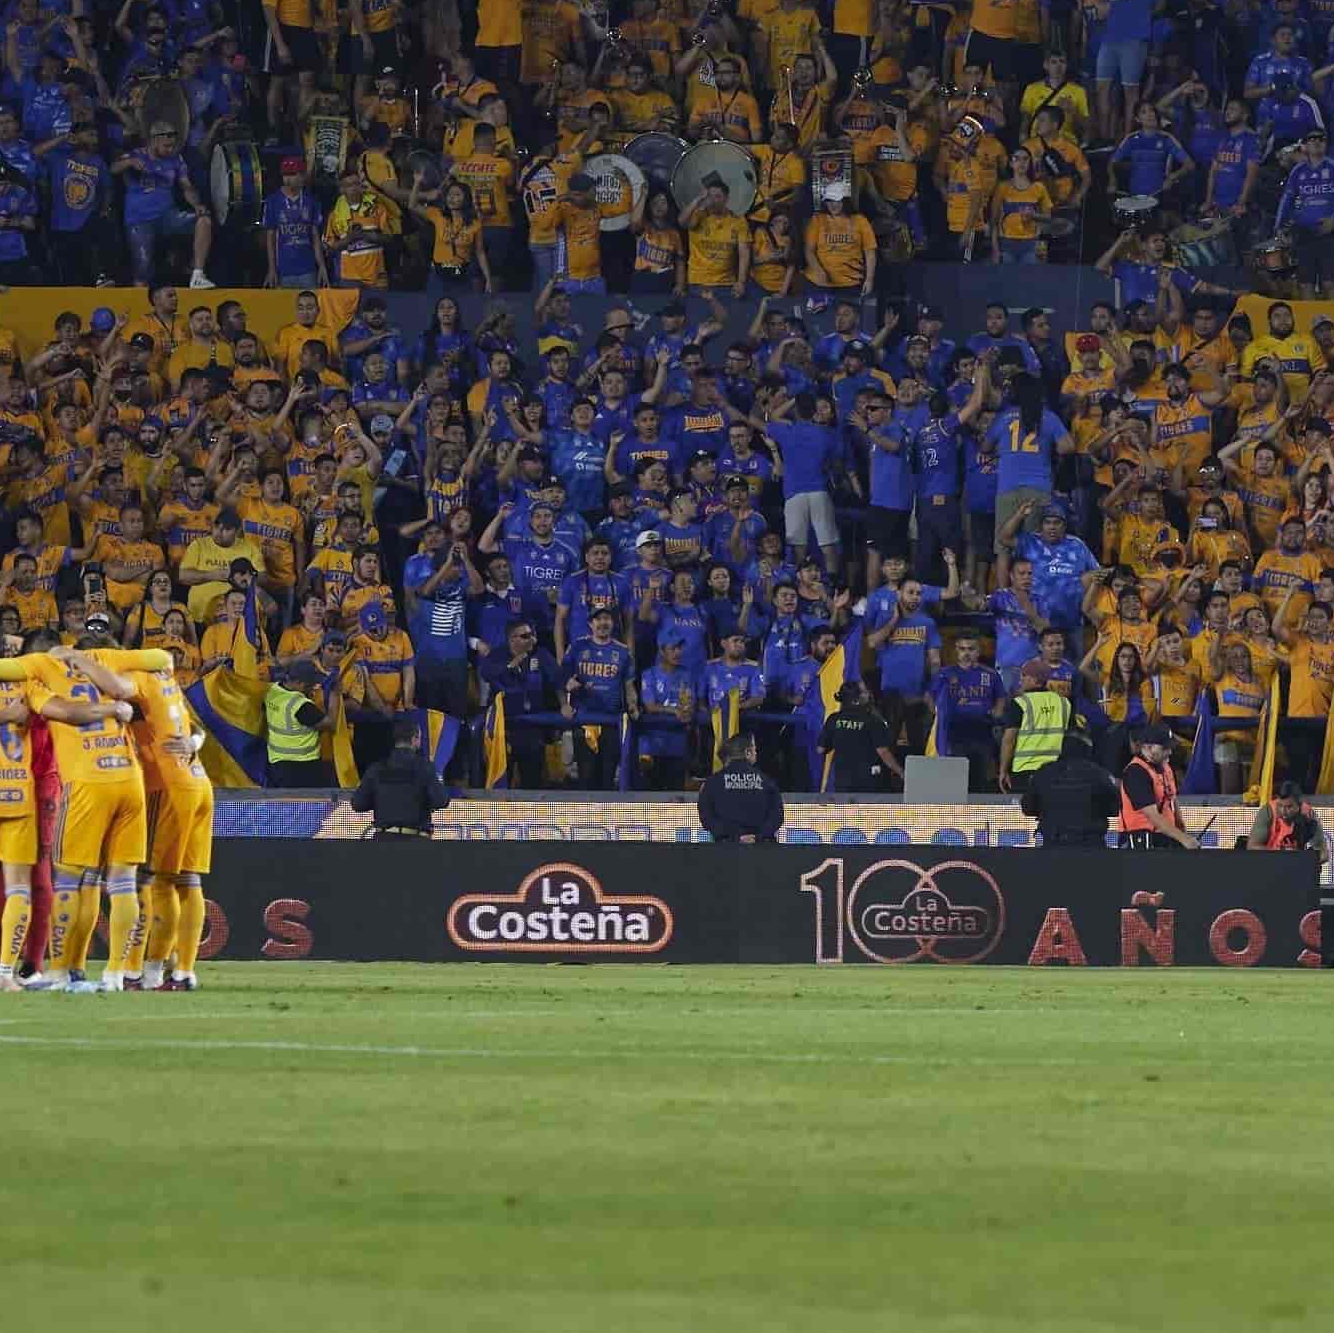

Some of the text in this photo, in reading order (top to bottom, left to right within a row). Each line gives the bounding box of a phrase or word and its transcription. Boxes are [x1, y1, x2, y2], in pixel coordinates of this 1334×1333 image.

[1009, 419, 1039, 452] 12
[577, 661, 620, 678] TIGRES
[835, 719, 865, 731] STAFF
[723, 781, 764, 791] MUNICIPAL
[541, 877, 580, 906] La
[916, 896, 939, 912] La
[467, 904, 650, 943] Costeña
[873, 907, 978, 933] Costeña
